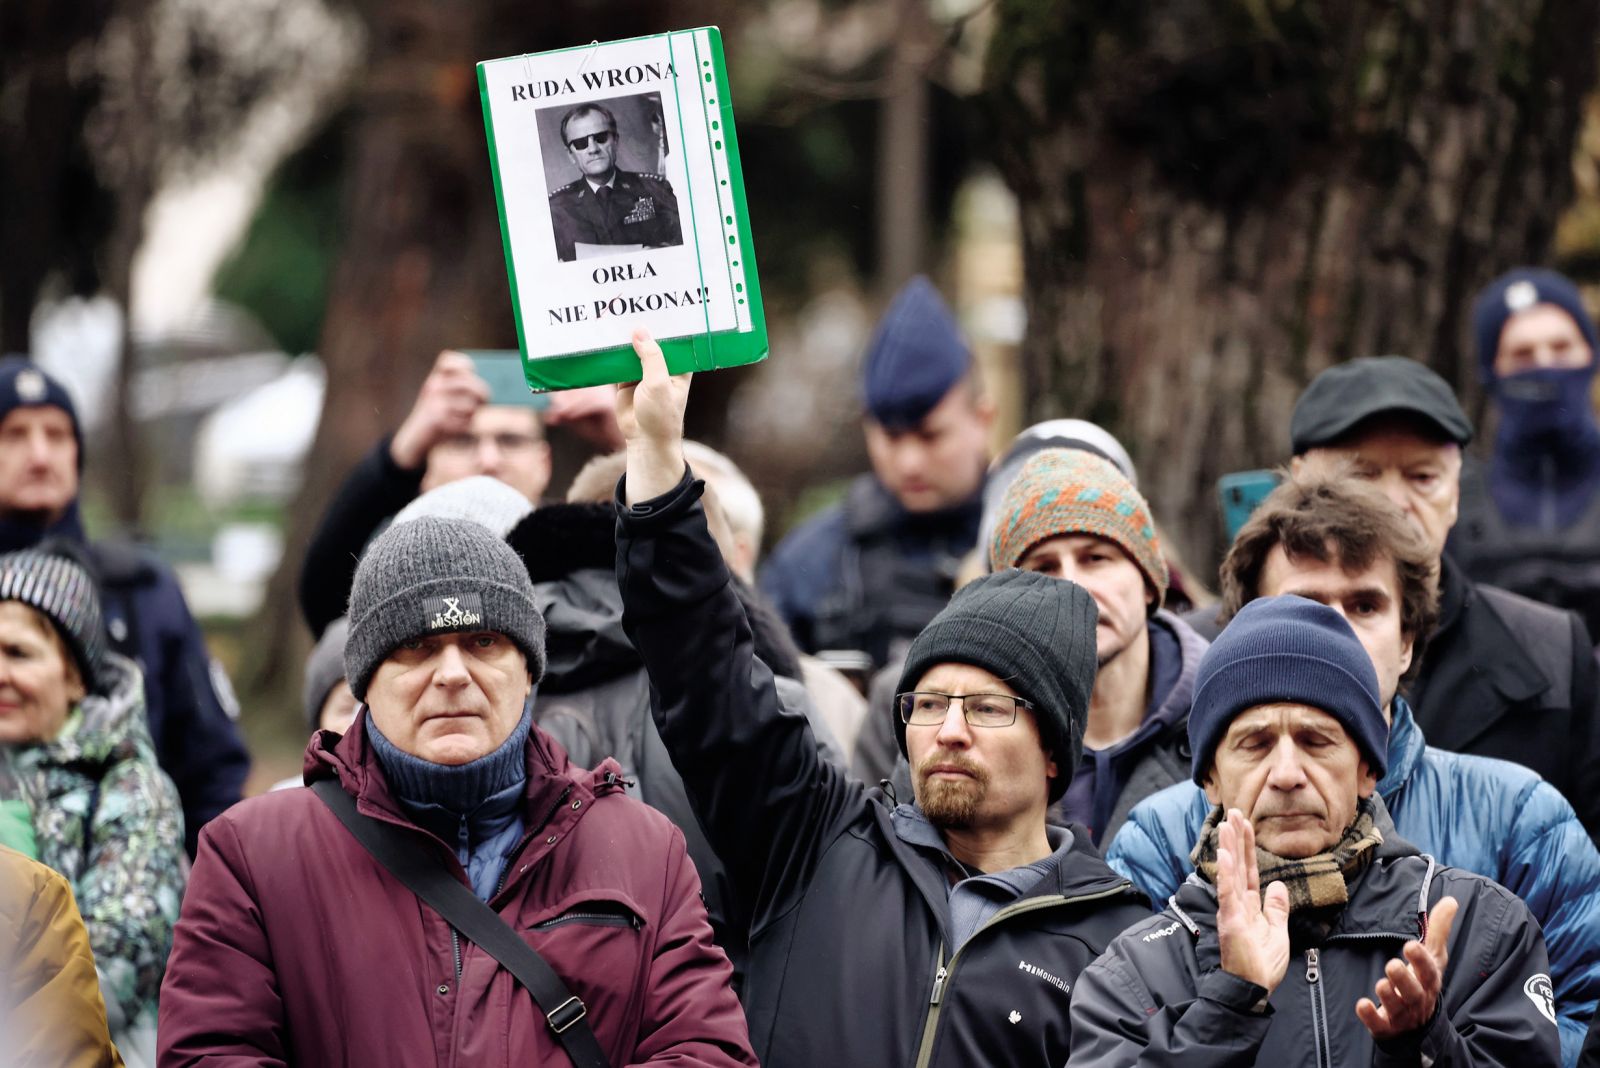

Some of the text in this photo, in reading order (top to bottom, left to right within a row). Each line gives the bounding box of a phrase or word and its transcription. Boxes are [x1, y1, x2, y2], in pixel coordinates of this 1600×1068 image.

[511, 61, 680, 102] RUDA WRONA
[592, 261, 658, 285] ORŁA
[548, 286, 711, 326] NIE POKONA!!
